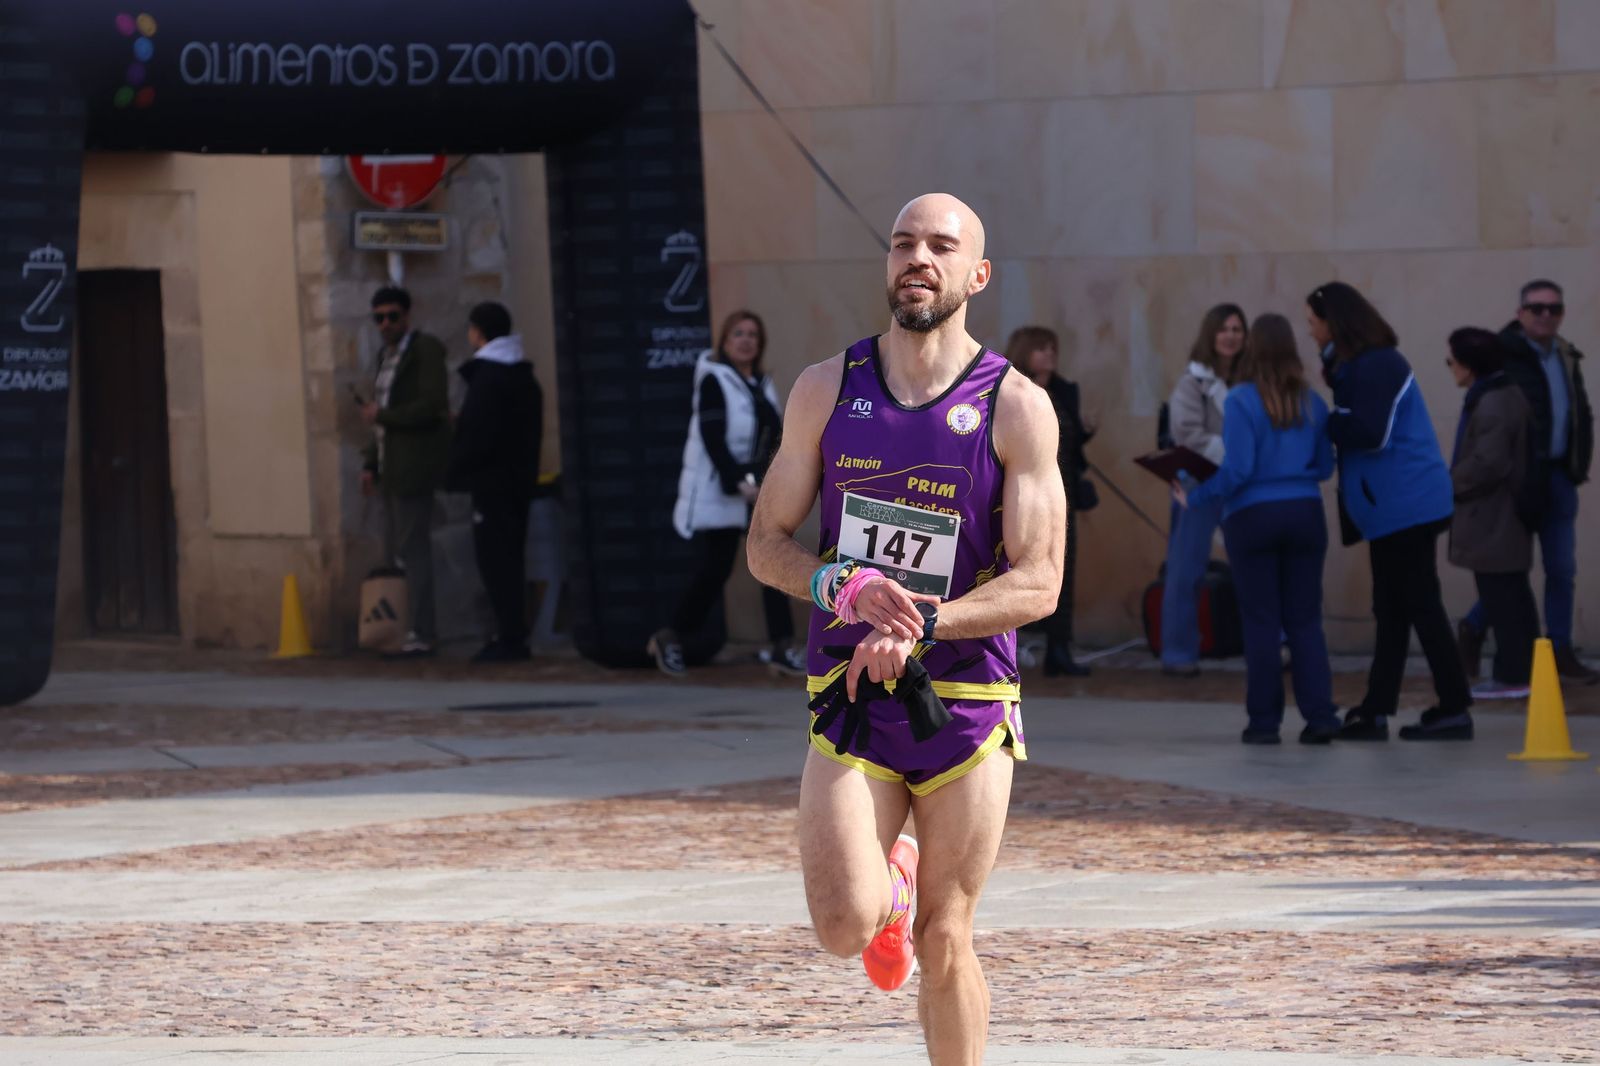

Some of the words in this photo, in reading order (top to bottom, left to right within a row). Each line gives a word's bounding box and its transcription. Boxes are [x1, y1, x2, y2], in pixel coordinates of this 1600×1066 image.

[835, 454, 882, 470] Jamón
[907, 476, 957, 499] PRIM
[862, 524, 933, 569] 147
